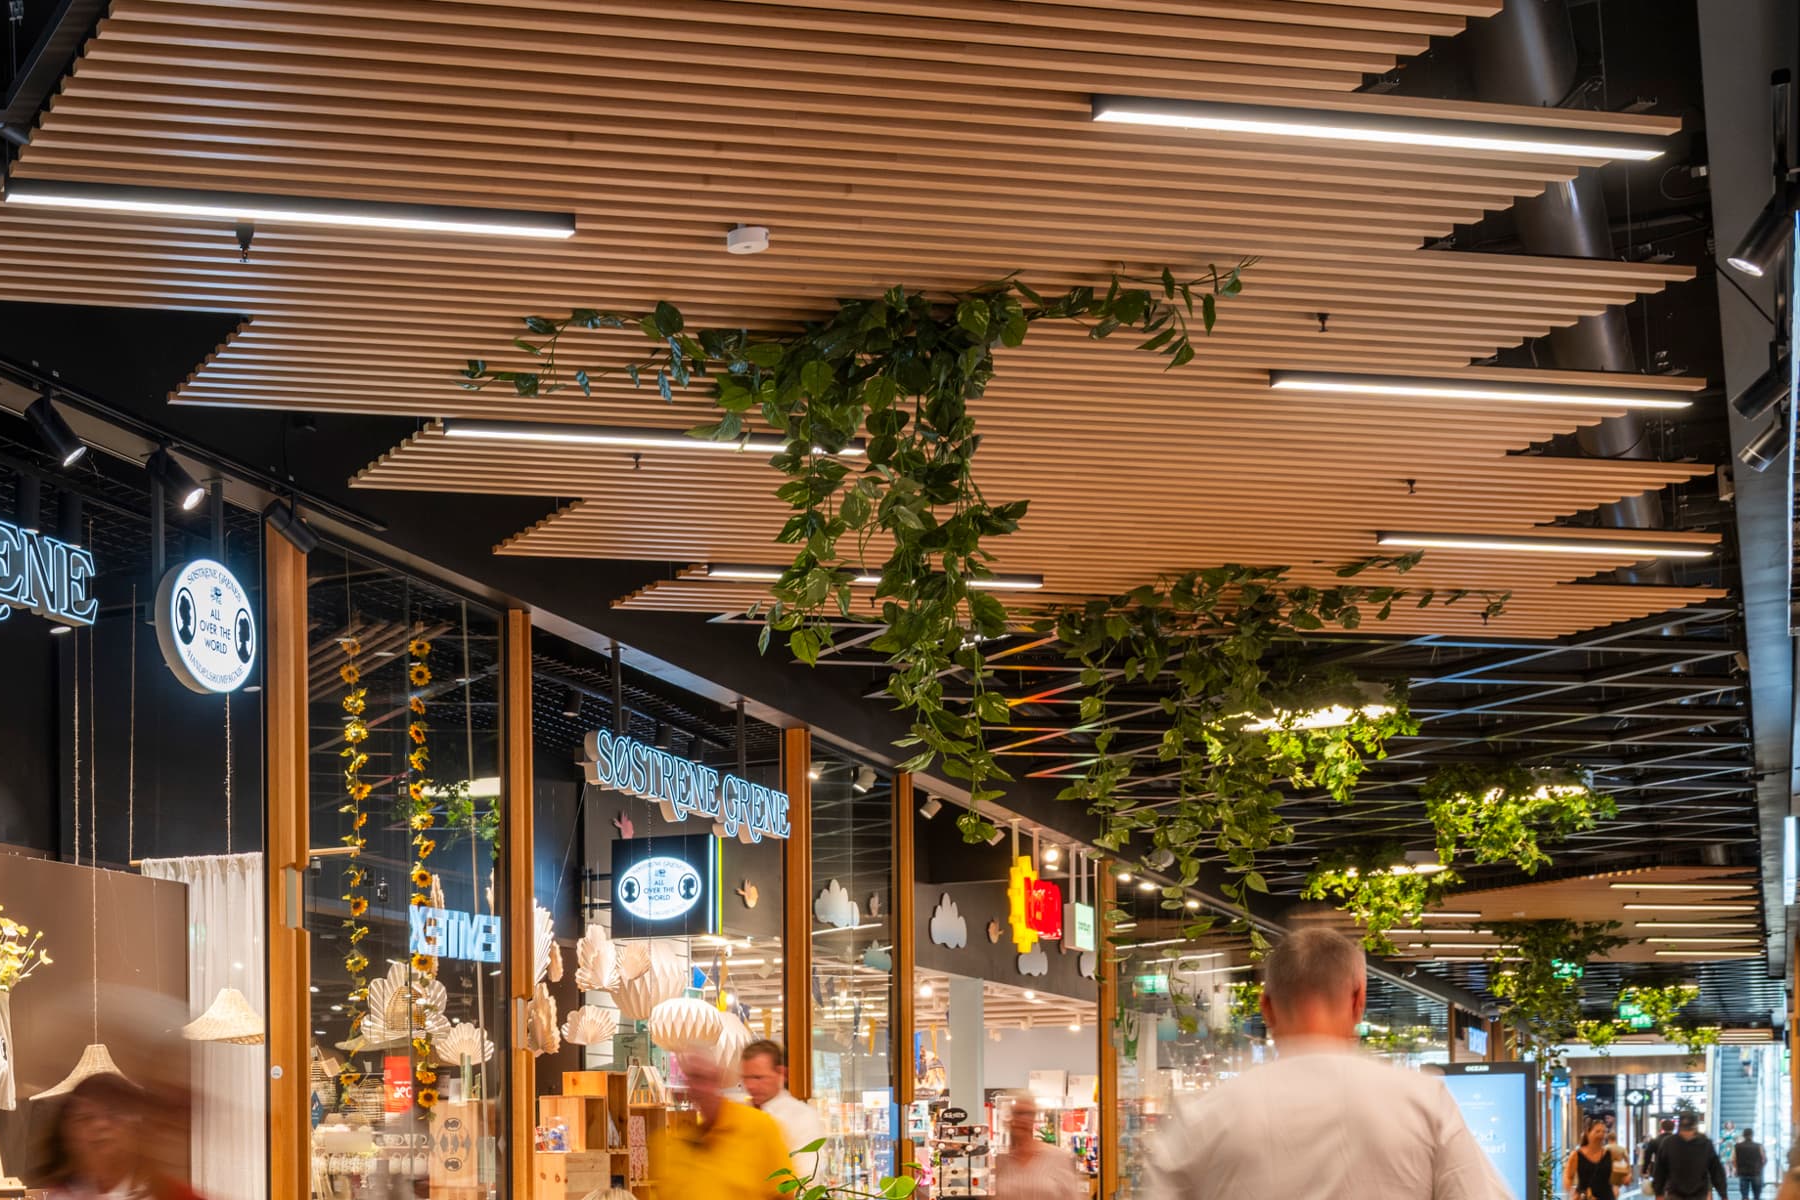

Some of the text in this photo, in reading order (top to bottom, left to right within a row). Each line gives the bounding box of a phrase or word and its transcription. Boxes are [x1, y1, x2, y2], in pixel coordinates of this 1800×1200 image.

[210, 608, 220, 621] ALL
[200, 620, 231, 640] OVER THE
[205, 638, 228, 655] WORLD
[596, 728, 791, 844] SØSTRENE GRENE
